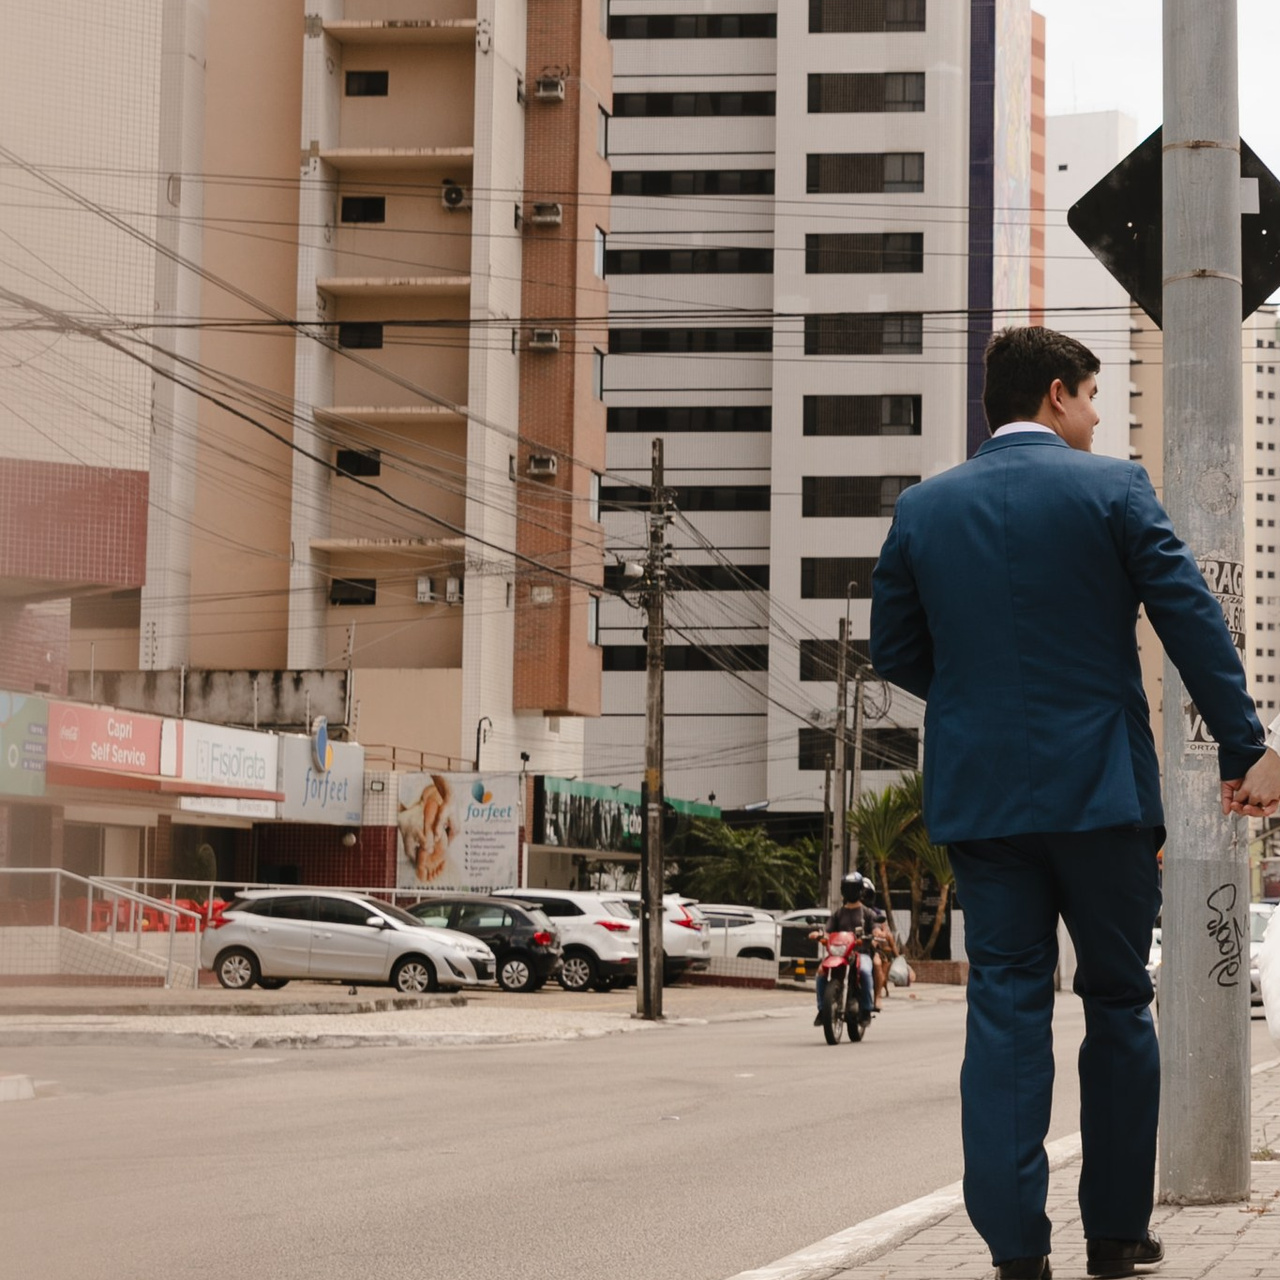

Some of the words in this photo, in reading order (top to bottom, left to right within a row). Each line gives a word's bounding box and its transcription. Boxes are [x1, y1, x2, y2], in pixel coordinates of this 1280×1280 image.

[107, 717, 133, 741] Capri
[90, 741, 110, 763] Self
[111, 745, 146, 767] Service
[302, 767, 349, 808] forfeet
[464, 802, 513, 822] forfeet
